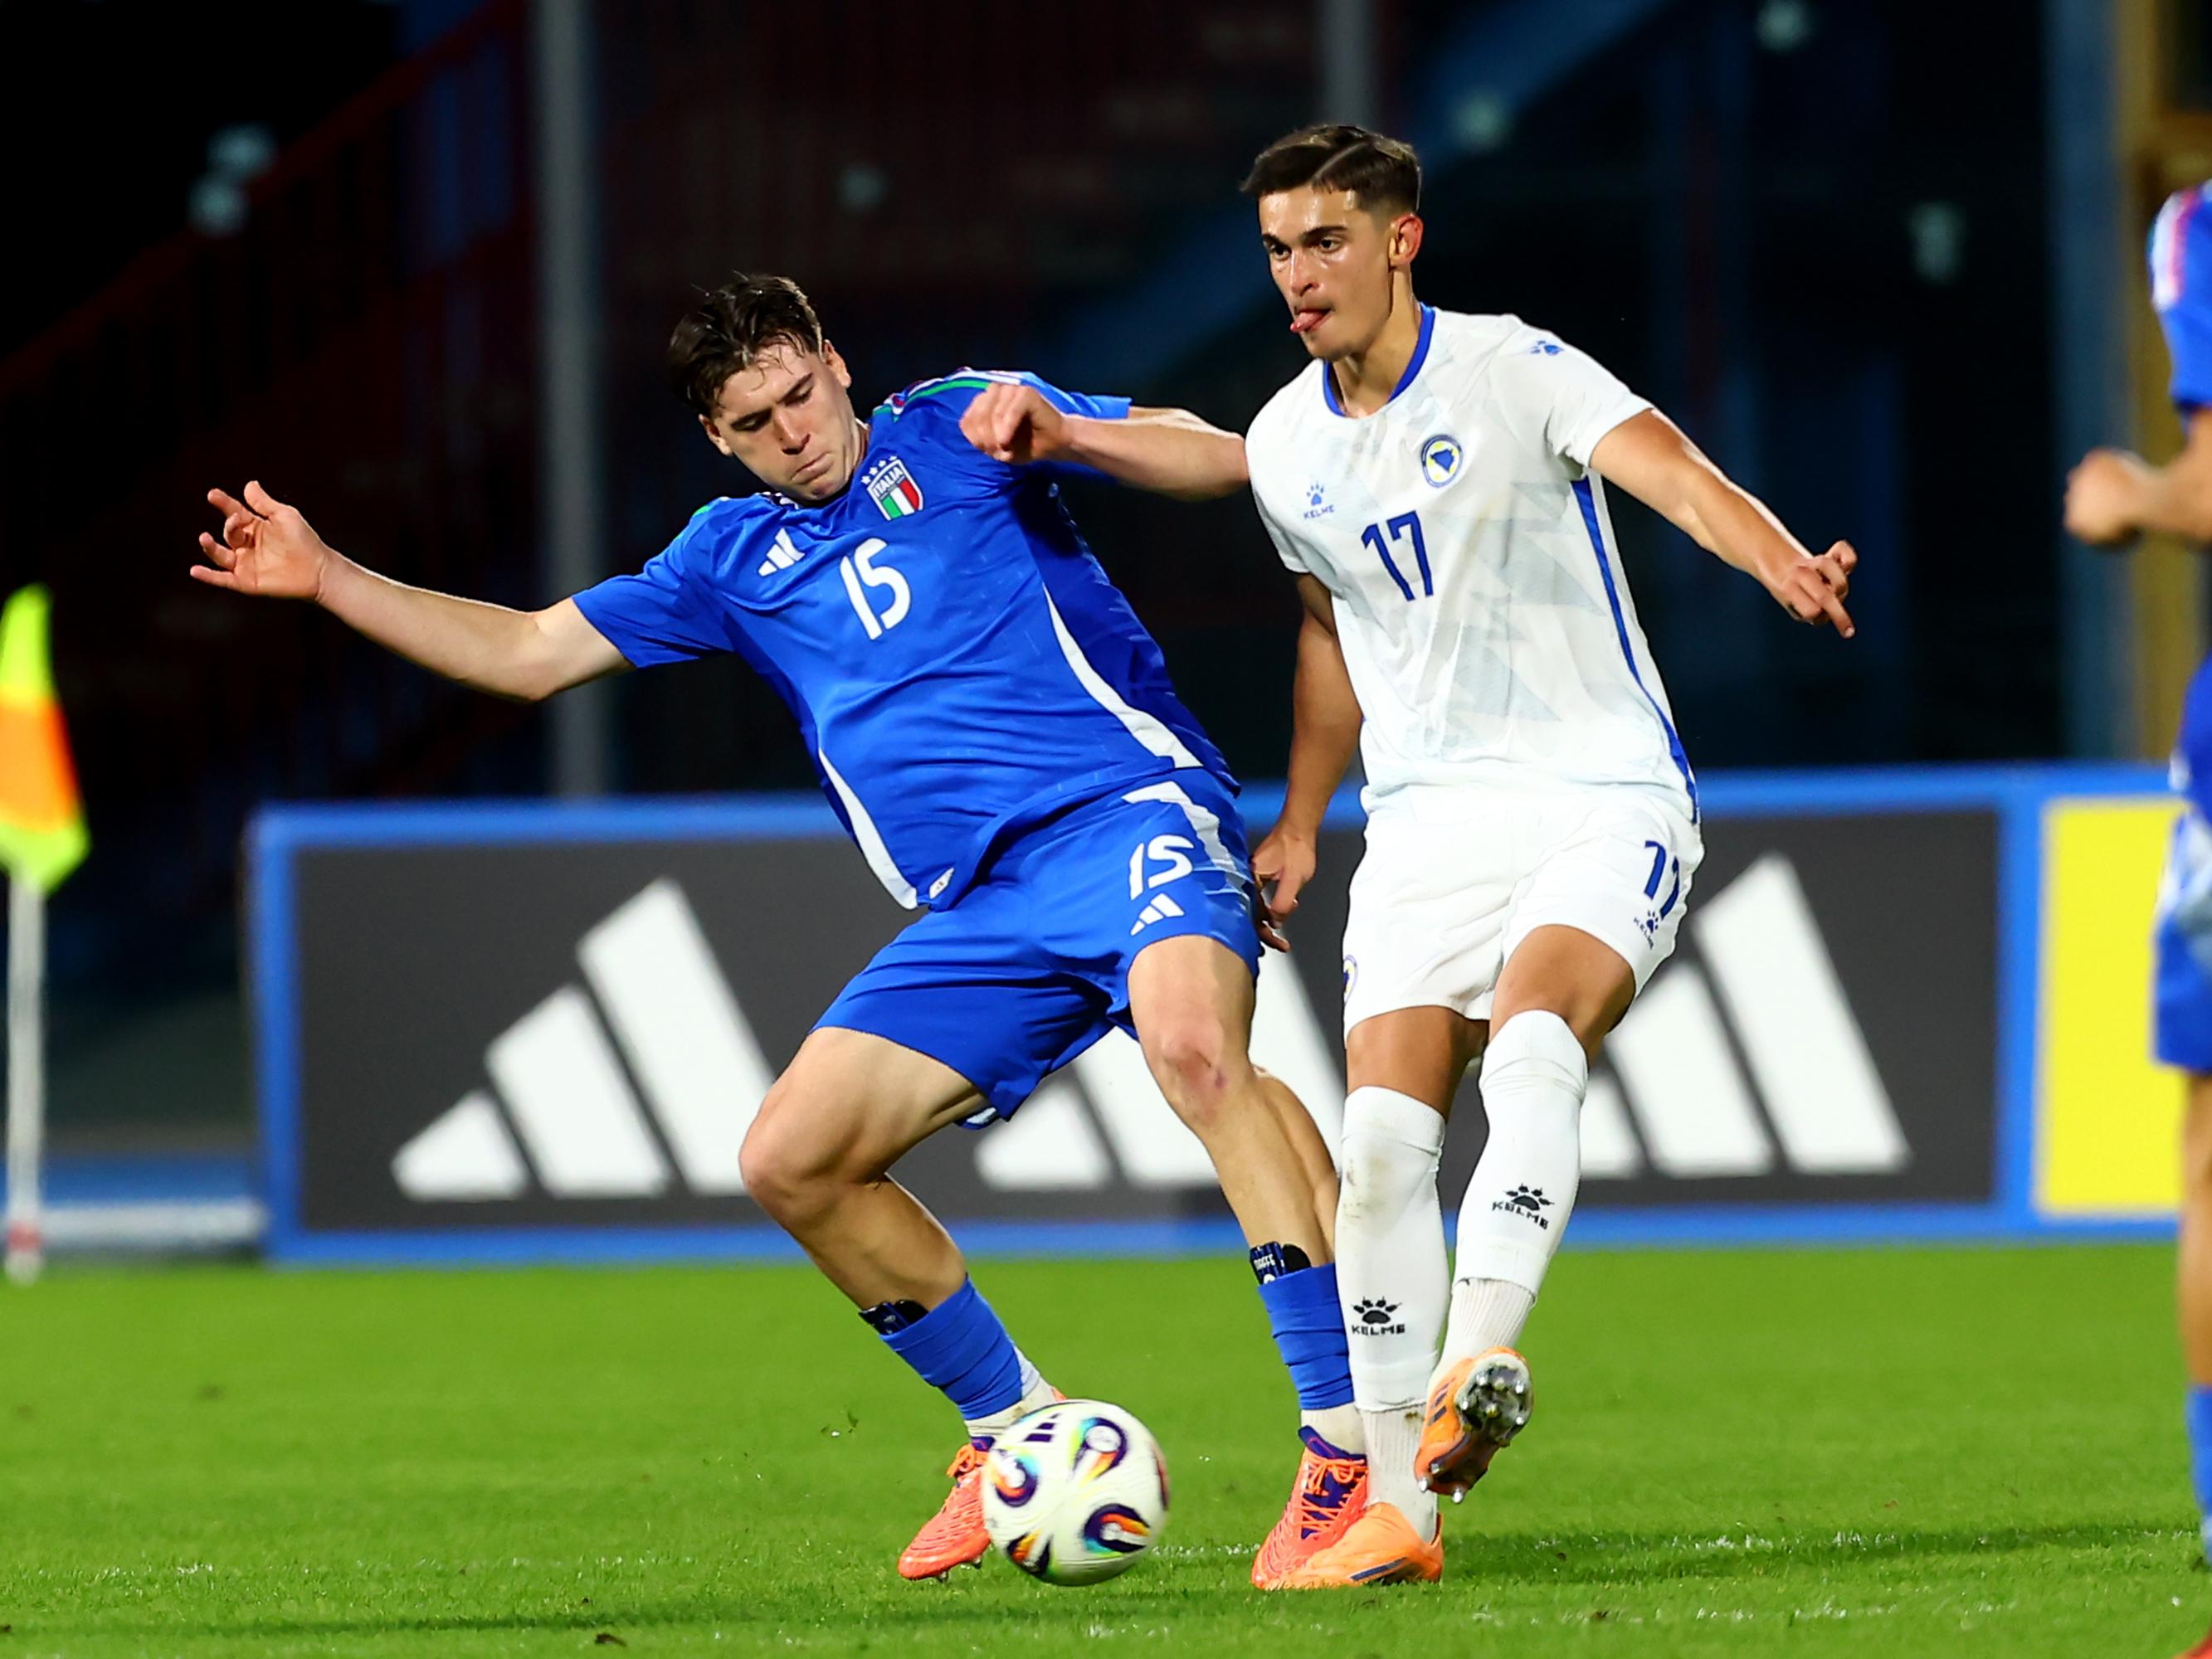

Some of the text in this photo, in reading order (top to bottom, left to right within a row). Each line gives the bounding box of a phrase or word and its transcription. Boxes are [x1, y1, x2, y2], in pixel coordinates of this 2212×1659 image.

[871, 465, 904, 498] ITALIA
[1303, 504, 1334, 519] KELME
[1361, 510, 1434, 601] 17
[840, 538, 911, 640] 15
[1129, 834, 1195, 901] 15
[1492, 1200, 1549, 1230] KELME
[1352, 1324, 1406, 1336] KELME
